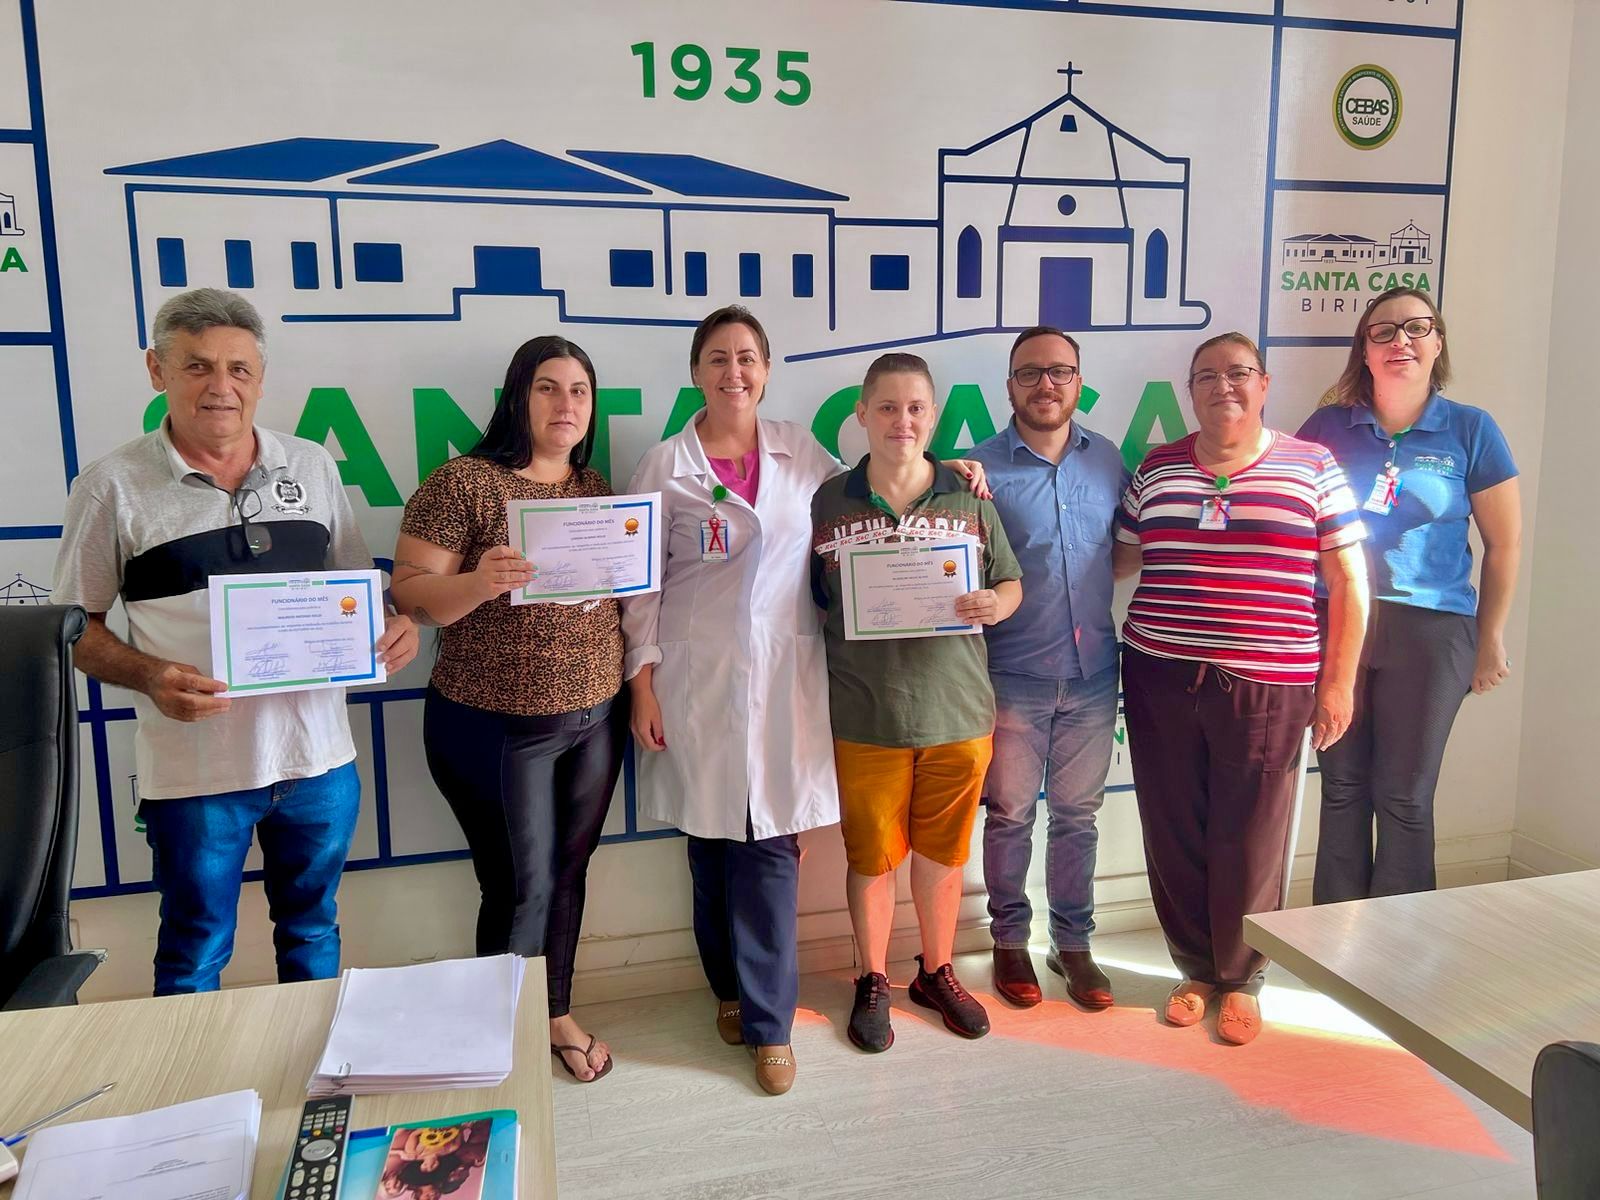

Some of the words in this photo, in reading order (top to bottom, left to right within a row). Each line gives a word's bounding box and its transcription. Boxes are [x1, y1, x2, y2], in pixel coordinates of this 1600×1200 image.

[631, 41, 812, 106] 1935
[1346, 98, 1390, 115] CEBAS
[1352, 115, 1382, 126] SAÚDE
[1281, 271, 1360, 291] SANTA
[1368, 272, 1431, 292] CASA
